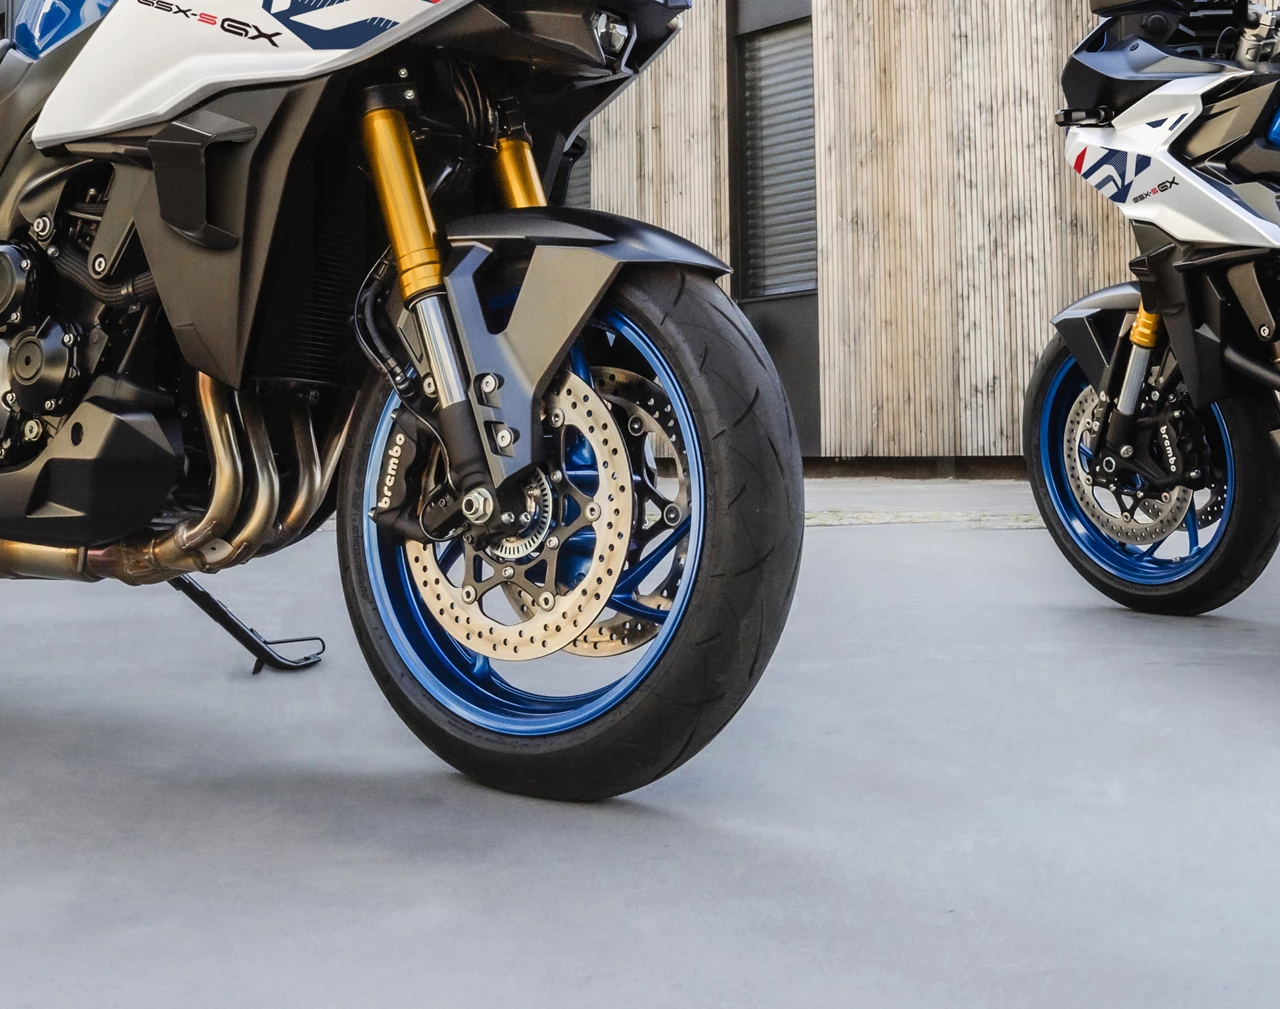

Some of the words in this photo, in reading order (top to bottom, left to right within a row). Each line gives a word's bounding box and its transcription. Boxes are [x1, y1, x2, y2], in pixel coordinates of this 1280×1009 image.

[220, 17, 283, 48] GX
[1157, 176, 1180, 193] GX
[1160, 425, 1177, 472] brembo
[377, 433, 405, 509] brembo
